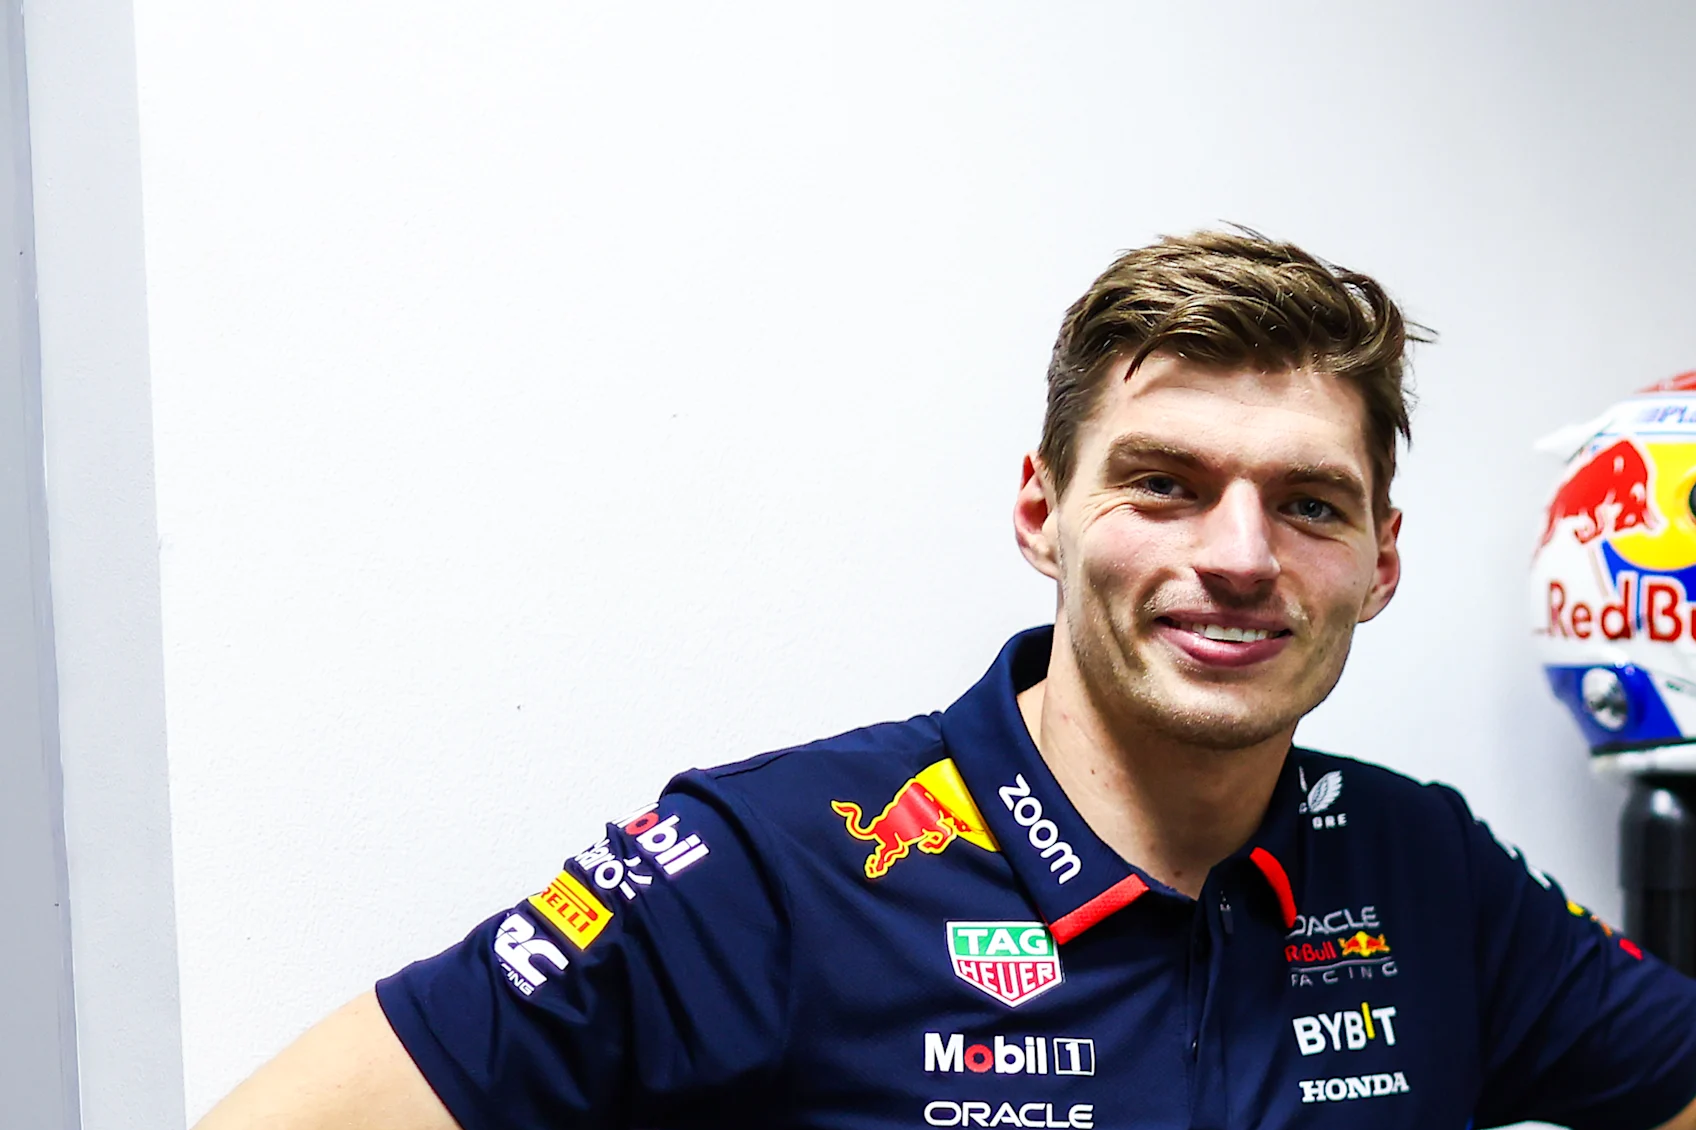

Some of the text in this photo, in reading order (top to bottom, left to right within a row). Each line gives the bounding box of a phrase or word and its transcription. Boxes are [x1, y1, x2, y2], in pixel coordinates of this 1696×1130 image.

[1548, 578, 1631, 640] Red
[998, 773, 1082, 885] zoom
[957, 927, 1048, 956] TAG
[959, 960, 1054, 1000] HEUER
[1292, 1002, 1397, 1056] BYBIT
[924, 1032, 1048, 1075] Mobil
[1298, 1071, 1410, 1103] HONDA
[923, 1100, 1094, 1129] ORACLE
